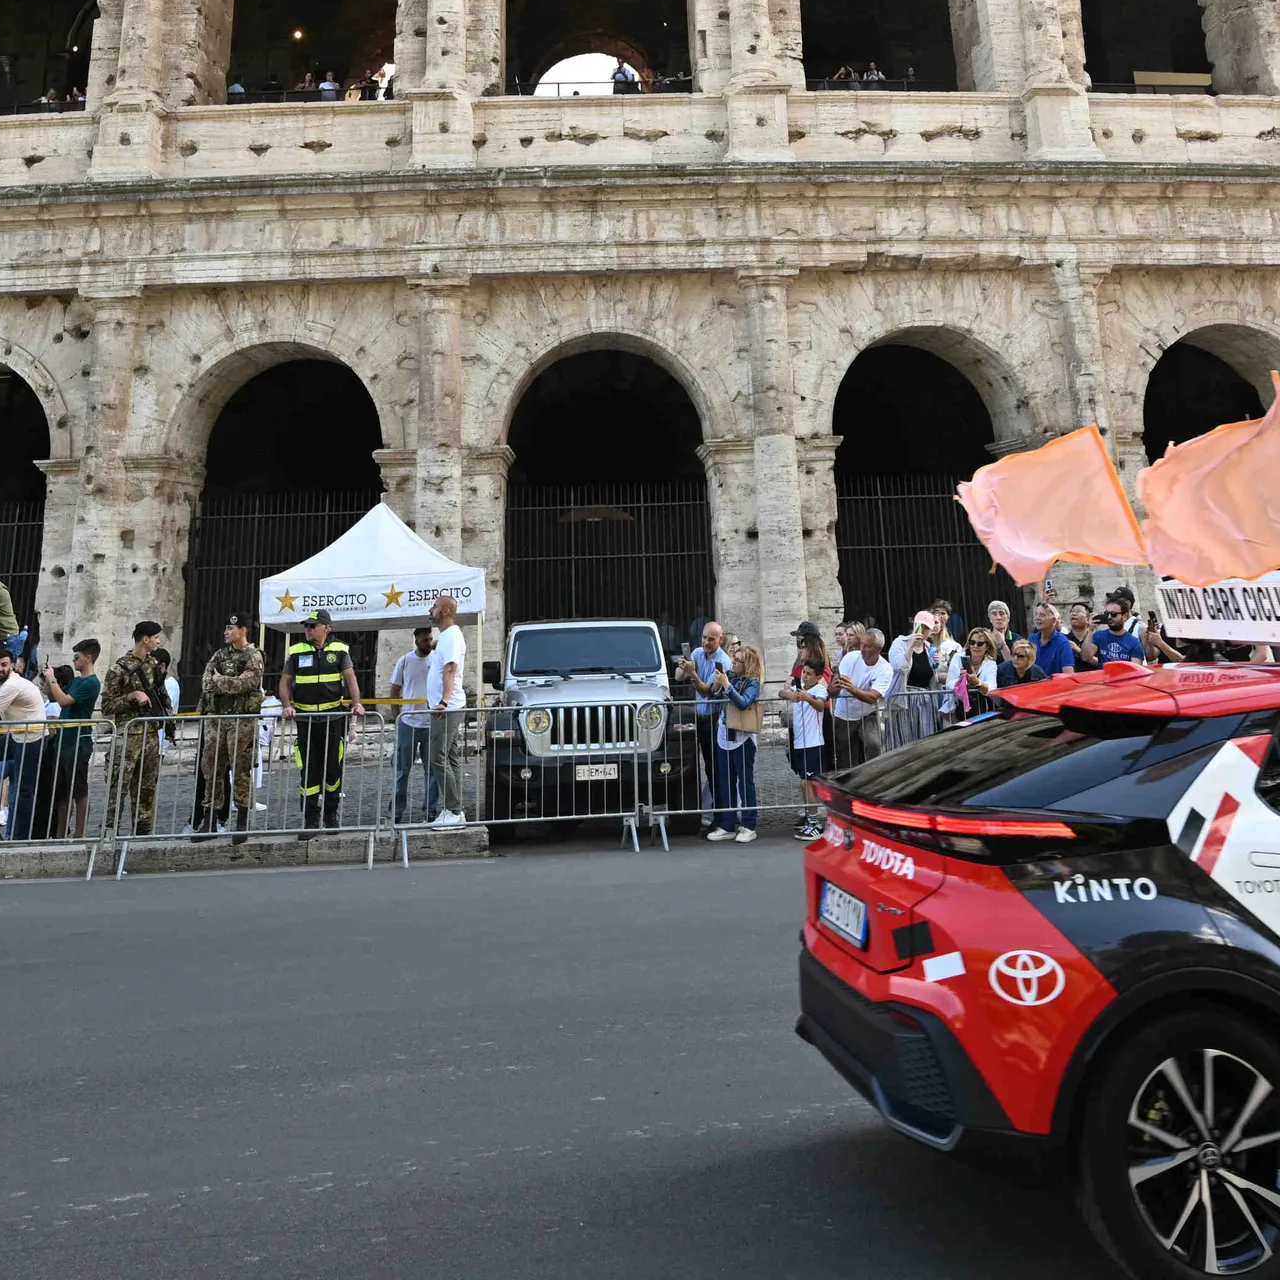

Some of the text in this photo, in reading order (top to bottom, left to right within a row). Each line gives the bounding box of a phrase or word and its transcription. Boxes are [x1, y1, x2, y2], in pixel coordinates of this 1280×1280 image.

[302, 593, 368, 607] ESERCITO
[408, 586, 472, 602] ESERCITO
[1160, 588, 1202, 621] INIZIO
[1202, 587, 1245, 621] GARA
[859, 838, 916, 880] TOYOTA
